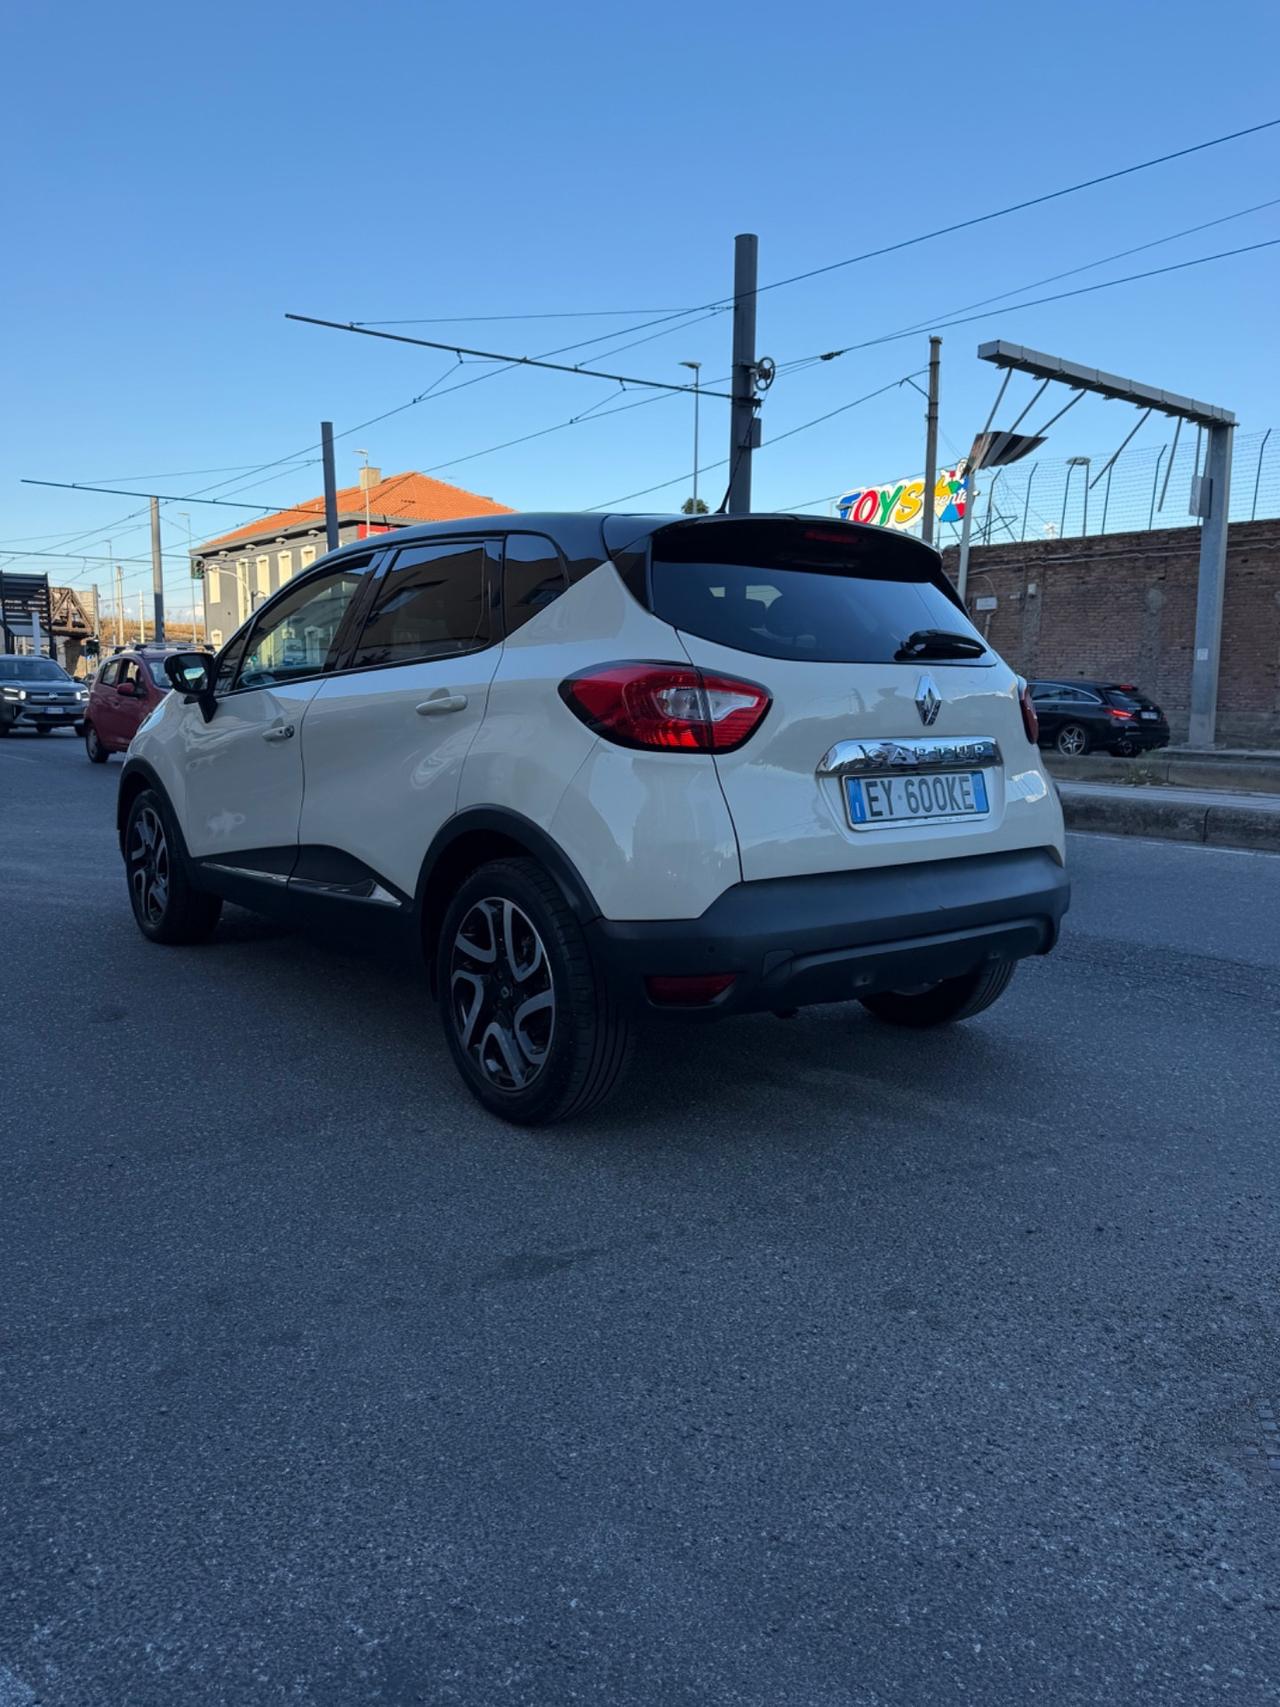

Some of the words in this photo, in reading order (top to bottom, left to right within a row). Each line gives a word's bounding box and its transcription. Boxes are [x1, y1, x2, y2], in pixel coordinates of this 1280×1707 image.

[836, 481, 925, 528] TOYS
[865, 779, 894, 817] EY
[904, 776, 975, 814] 600KE
